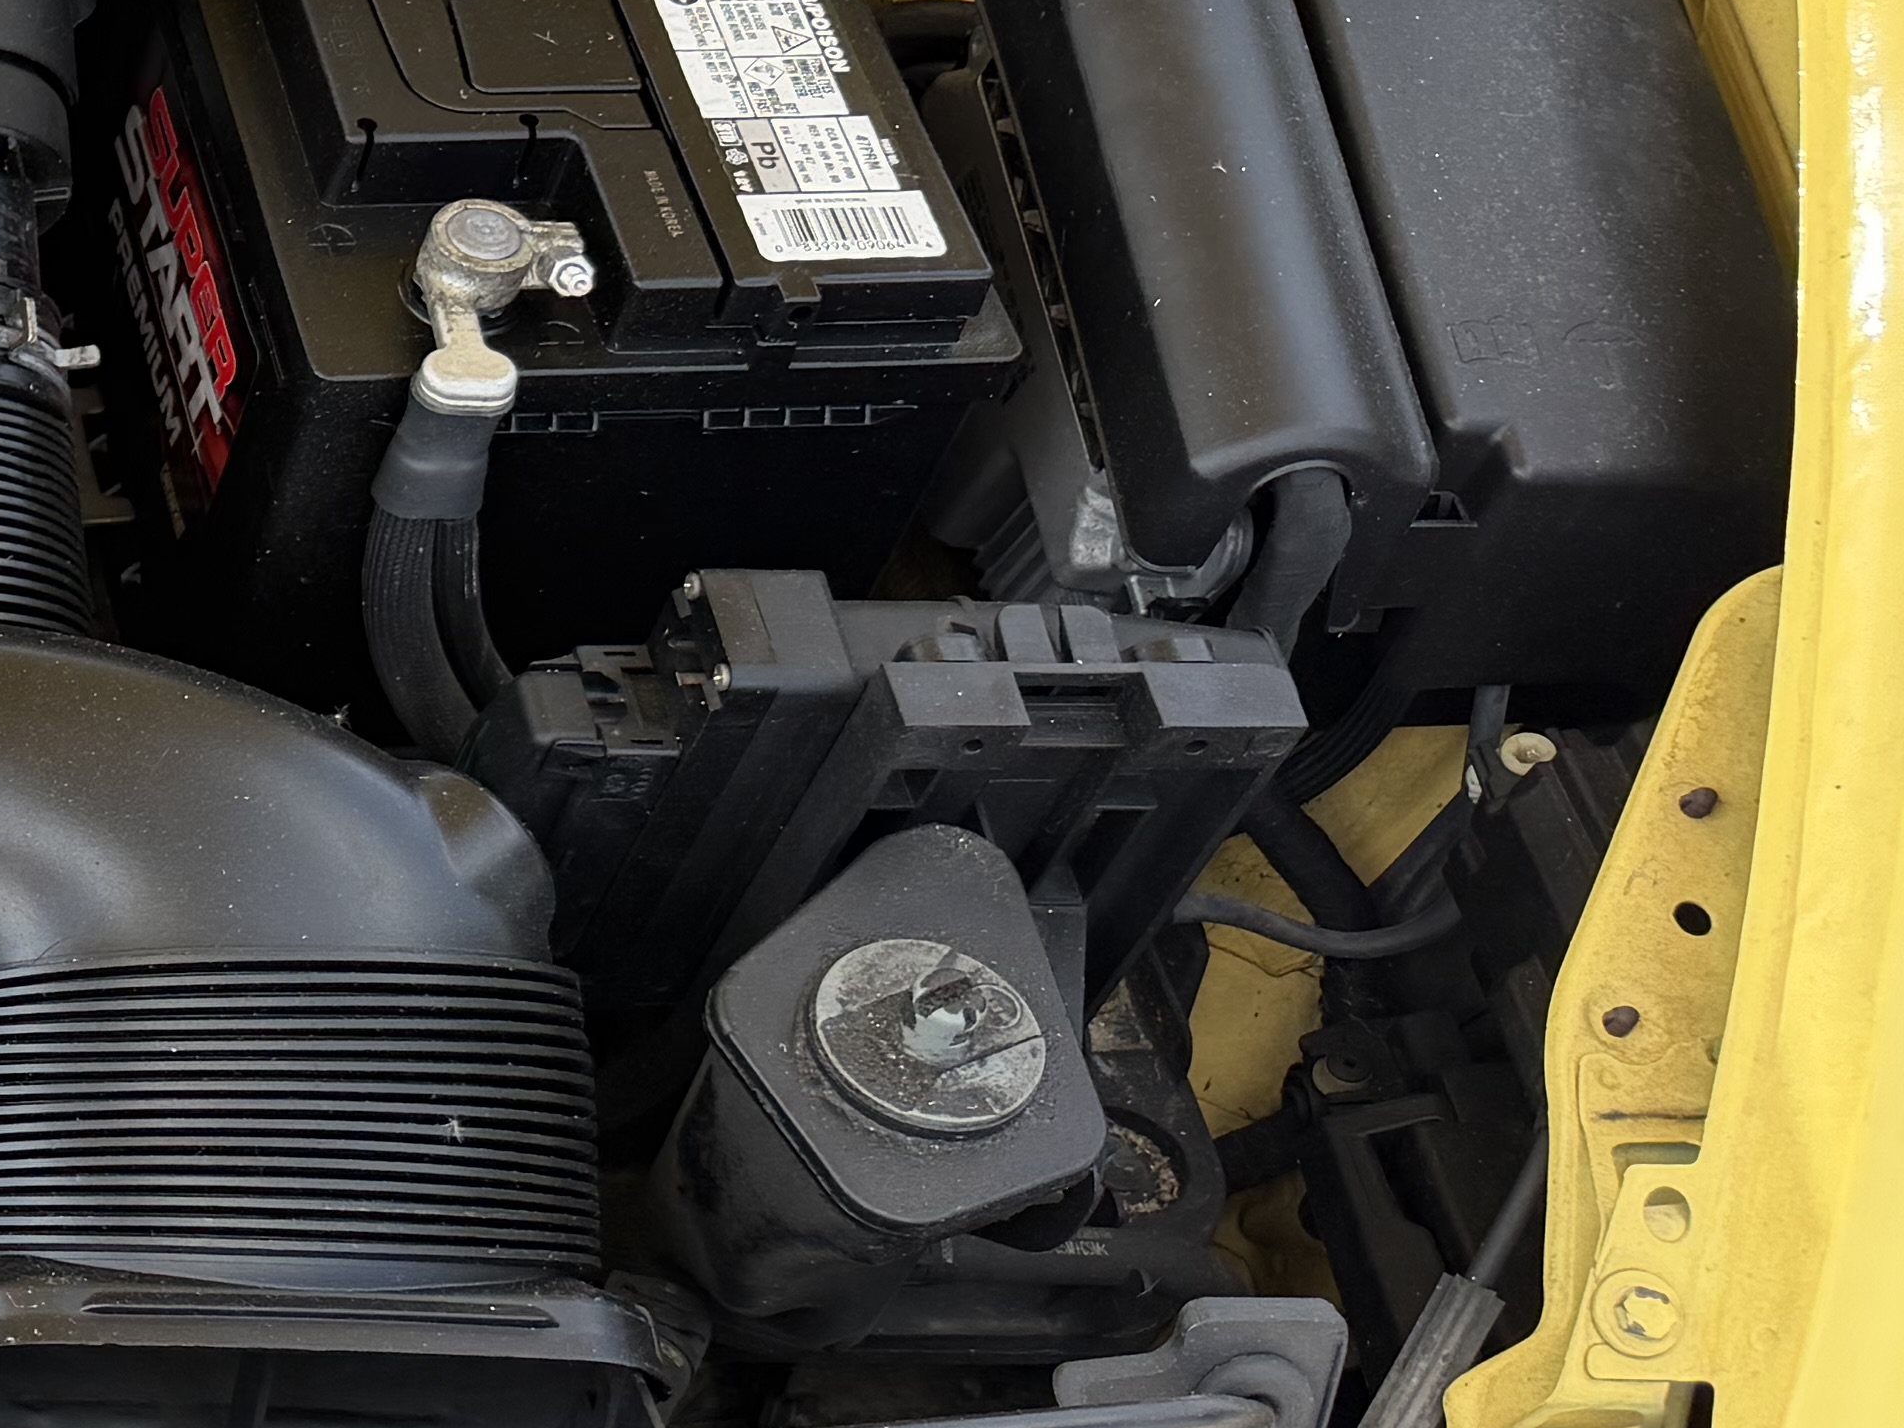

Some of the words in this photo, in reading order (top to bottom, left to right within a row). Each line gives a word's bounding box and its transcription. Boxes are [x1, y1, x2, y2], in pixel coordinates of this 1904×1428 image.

[115, 105, 223, 425] START
[143, 87, 238, 402] SUPER
[749, 141, 783, 169] Pb
[108, 197, 183, 447] PREMIUM
